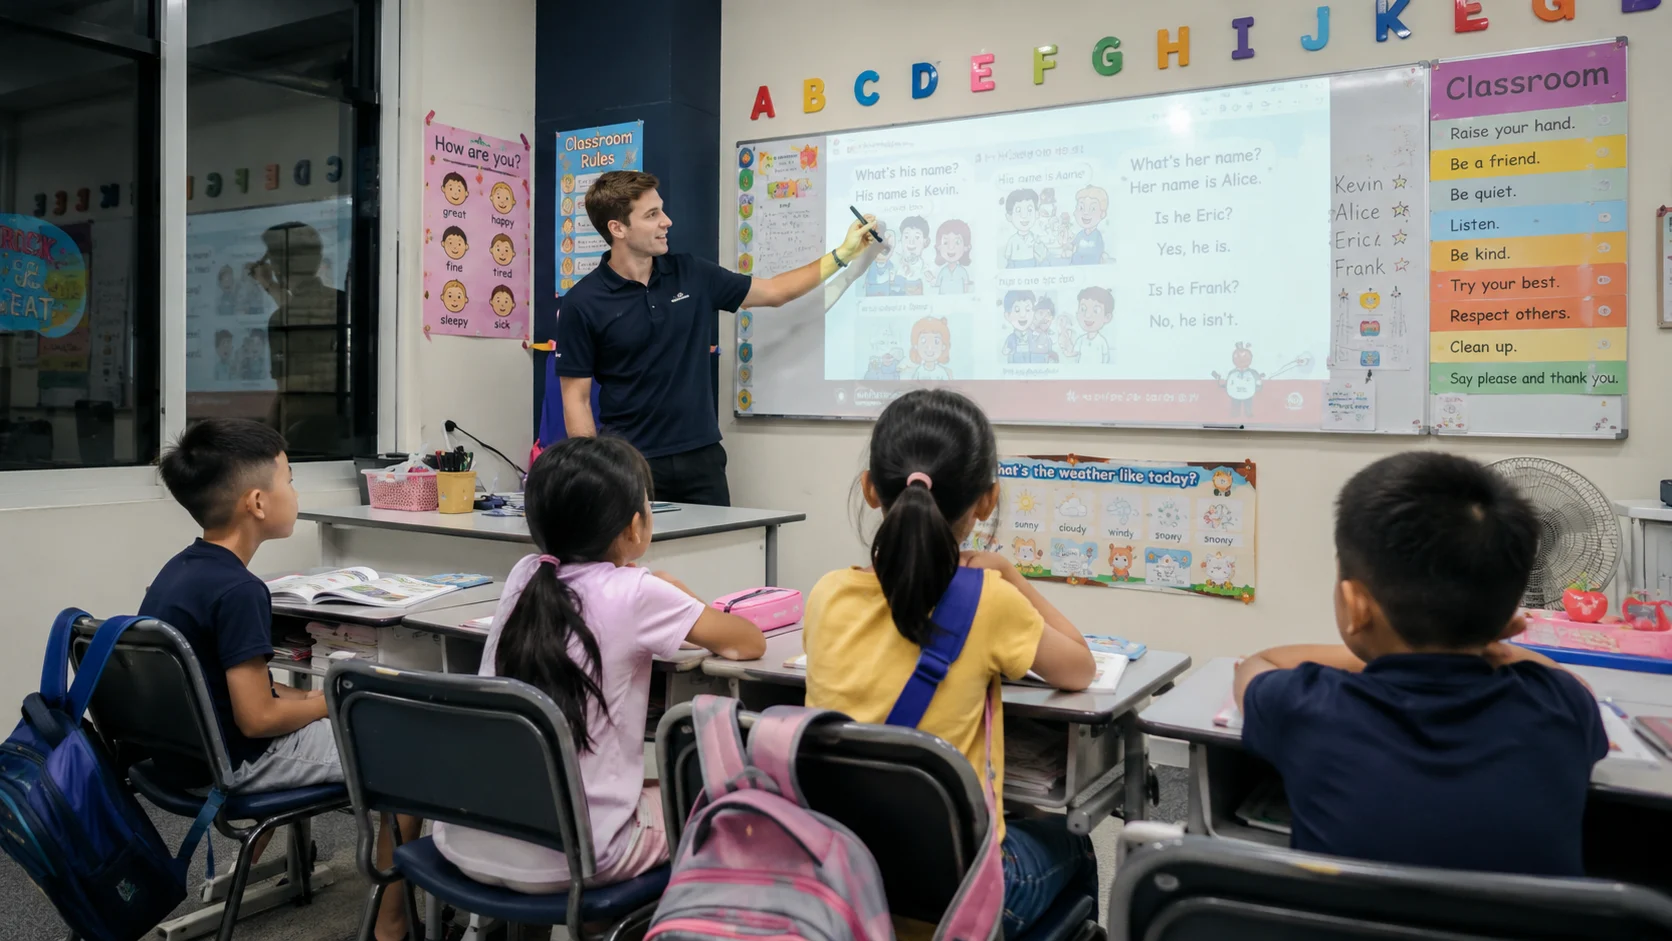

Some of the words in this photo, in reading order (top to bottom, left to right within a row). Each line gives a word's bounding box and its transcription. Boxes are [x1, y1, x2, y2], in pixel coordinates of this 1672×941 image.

[750, 85, 776, 121] A
[803, 77, 826, 114] B
[854, 70, 880, 107] C
[911, 62, 939, 100] D
[970, 53, 996, 93] E
[1033, 44, 1058, 86] F
[1091, 36, 1123, 77] G
[1156, 26, 1190, 70] H
[1231, 16, 1255, 60] I
[1300, 5, 1330, 51] J
[1375, 0, 1412, 42] K
[1454, 0, 1489, 33] E
[1447, 67, 1609, 100] Classroom
[1451, 127, 1488, 139] Raise
[1495, 124, 1528, 139] your
[1534, 116, 1575, 132] hand.
[566, 132, 633, 153] Classroom
[436, 135, 464, 154] How
[468, 148, 490, 160] are
[493, 154, 521, 169] you?
[582, 152, 615, 168] Rules
[1131, 155, 1180, 171] What's
[1186, 154, 1210, 167] her
[1216, 148, 1261, 164] name?
[1451, 158, 1468, 170] Be
[1475, 160, 1483, 168] a
[1490, 151, 1540, 167] friend.
[855, 167, 895, 181] What's
[900, 166, 916, 177] his
[921, 163, 959, 176] name?
[1131, 181, 1157, 194] Her
[1162, 180, 1199, 191] name
[1206, 175, 1216, 188] is
[1222, 172, 1261, 187] Alice.
[1335, 175, 1383, 194] Kevin
[856, 190, 873, 202] His
[878, 190, 907, 200] name
[912, 186, 920, 197] is
[925, 183, 958, 196] Kevin.
[1451, 188, 1468, 201] Be
[1475, 186, 1516, 203] quiet.
[443, 209, 466, 219] great
[1155, 212, 1168, 224] Is
[1174, 210, 1191, 223] he
[1197, 207, 1232, 222] Eric?
[1335, 203, 1380, 221] Alice
[492, 215, 514, 229] happy
[1450, 218, 1500, 233] Listen.
[1157, 243, 1186, 256] Yes,
[1192, 240, 1209, 253] he
[1216, 240, 1230, 252] is.
[1451, 249, 1468, 261] Be
[1476, 247, 1510, 260] kind.
[446, 261, 462, 272] fine
[493, 268, 512, 278] tired
[1336, 258, 1385, 277] Frank
[1149, 283, 1162, 296] Is
[1168, 282, 1184, 296] he
[1190, 280, 1239, 294] Frank?
[1451, 279, 1475, 294] Try
[1482, 281, 1515, 294] your
[1522, 276, 1560, 290] best.
[441, 315, 468, 328] sleepy
[494, 319, 510, 329] sick
[1150, 315, 1174, 329] No,
[1180, 313, 1196, 326] he
[1203, 312, 1237, 326] isn't.
[1451, 309, 1509, 325] Respect
[1516, 307, 1570, 320] others.
[1451, 340, 1489, 353] Clean
[1496, 342, 1517, 357] up.
[1451, 372, 1473, 388] Say
[1478, 372, 1517, 388] please
[1522, 372, 1544, 384] and
[1550, 372, 1587, 385] thank
[1592, 374, 1619, 388] you.
[997, 463, 1029, 477] hat's
[1034, 464, 1055, 478] the
[1058, 466, 1116, 482] weather
[1119, 468, 1144, 483] like
[1148, 471, 1197, 488] today?
[1014, 520, 1040, 532] sunny
[1108, 528, 1134, 541] windy
